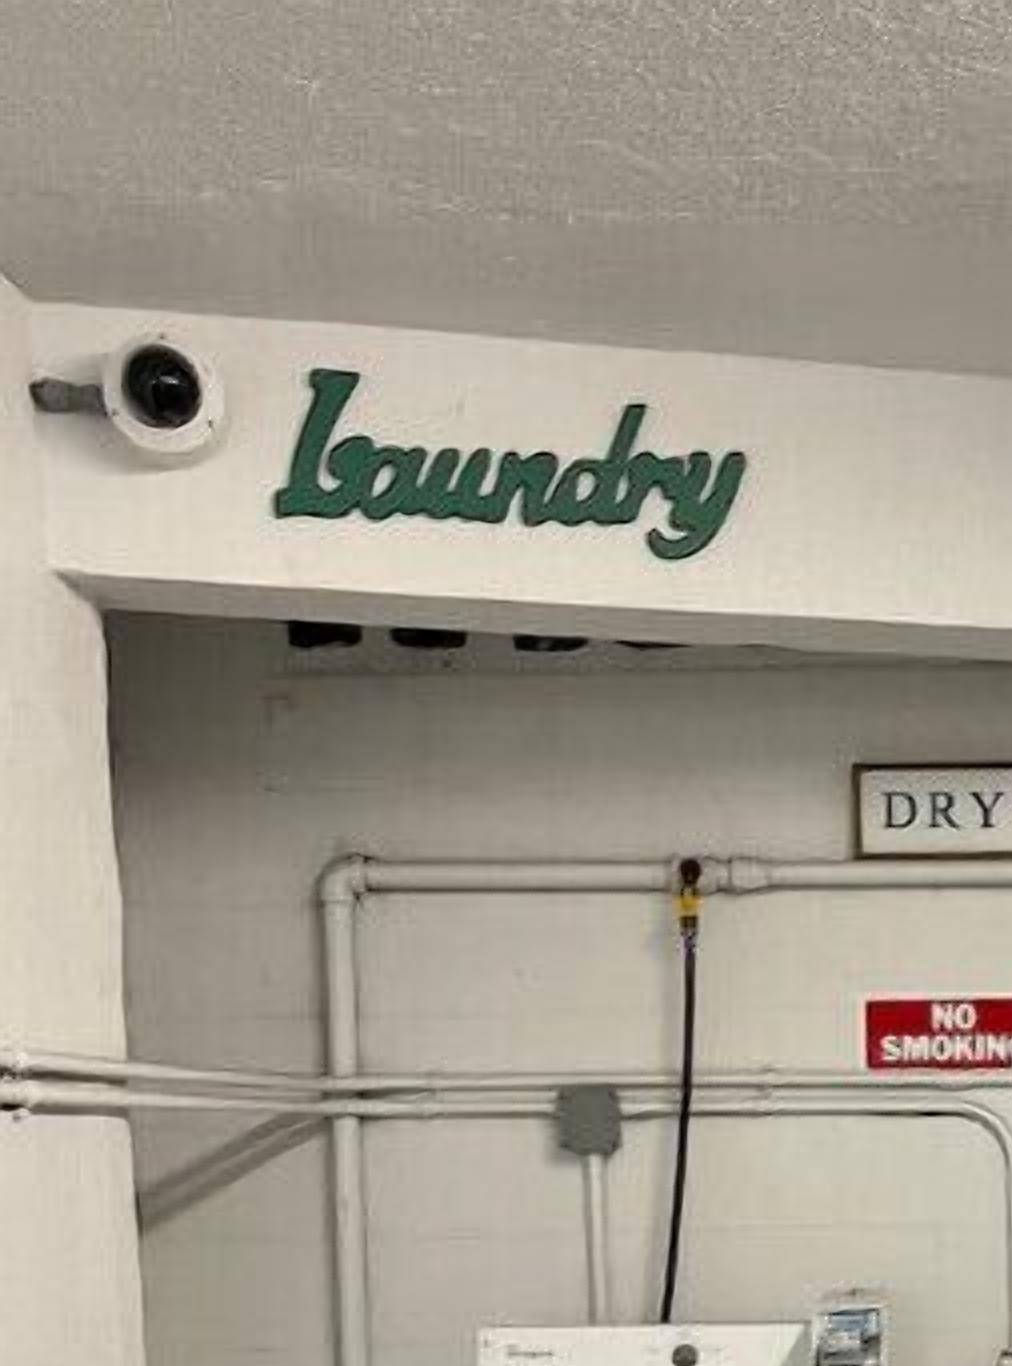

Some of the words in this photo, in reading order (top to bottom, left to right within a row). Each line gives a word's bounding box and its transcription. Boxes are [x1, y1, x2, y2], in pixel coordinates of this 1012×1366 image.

[273, 368, 746, 560] Laundry
[881, 791, 1005, 829] DRY
[930, 1003, 978, 1030] NO
